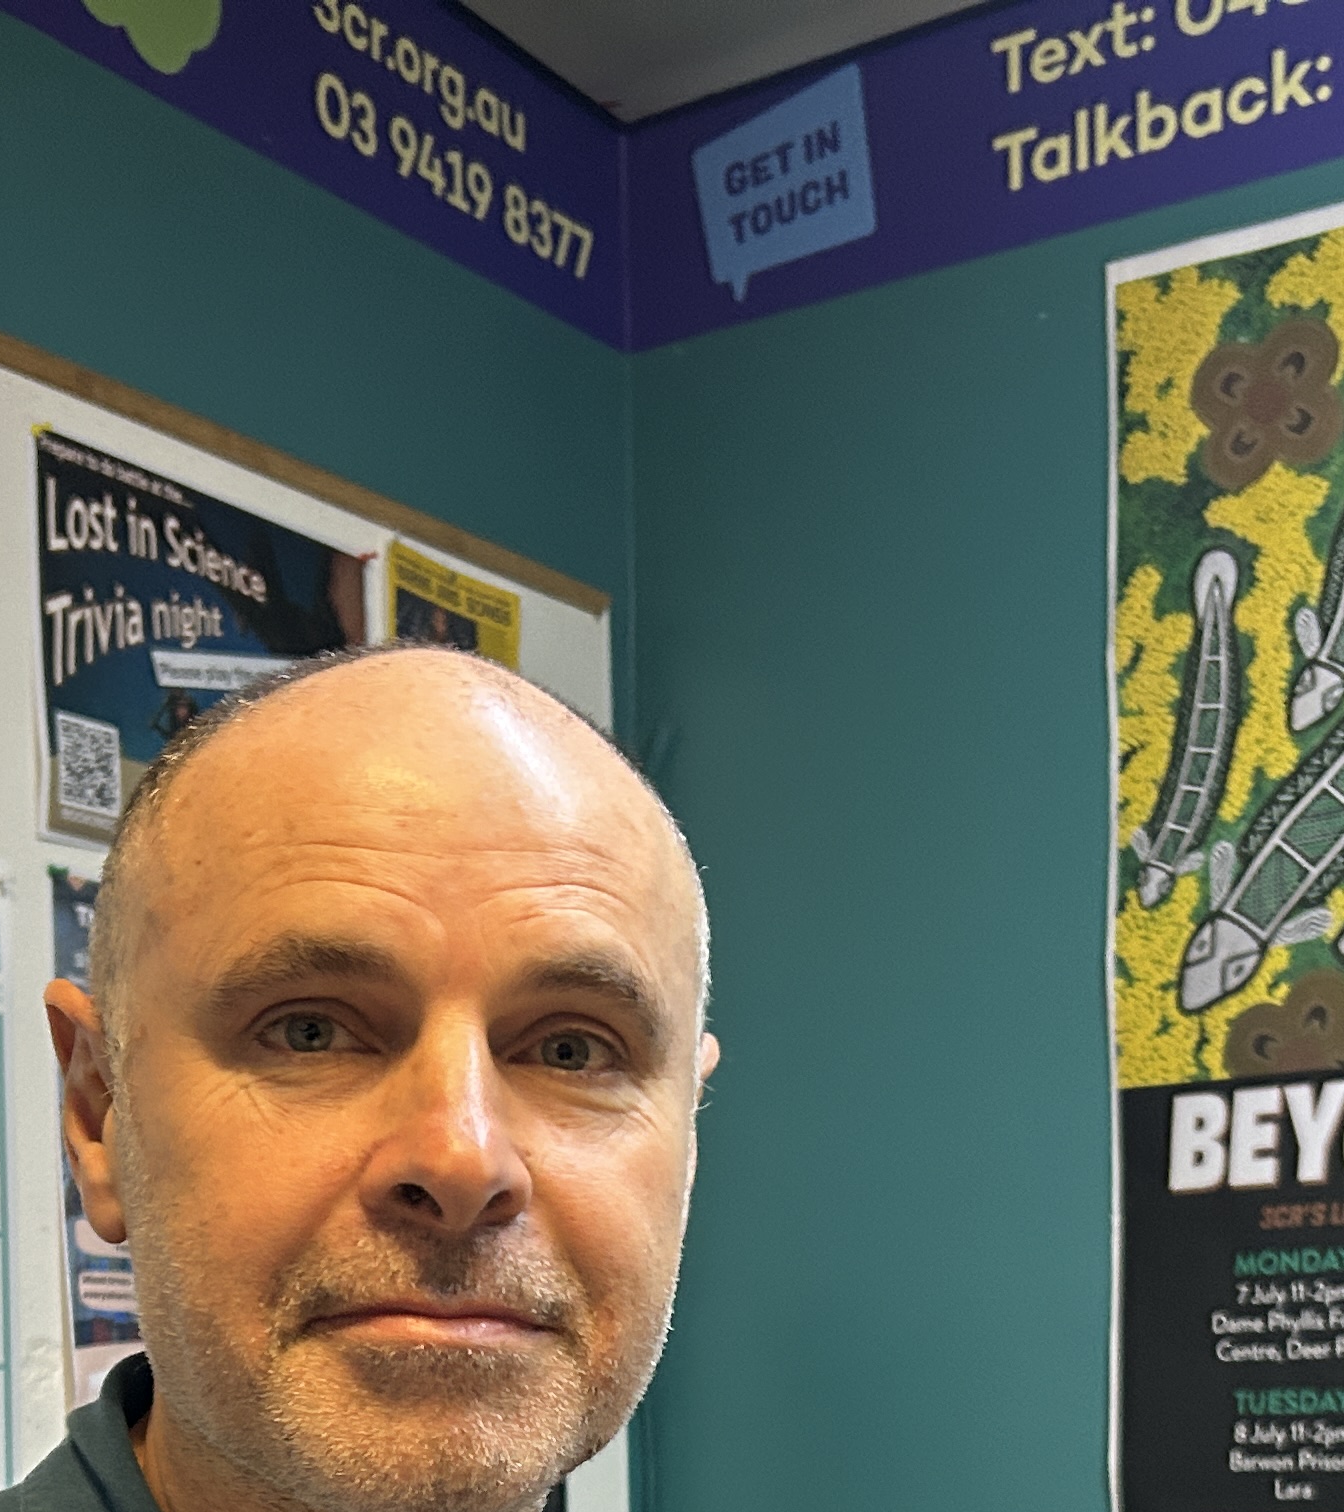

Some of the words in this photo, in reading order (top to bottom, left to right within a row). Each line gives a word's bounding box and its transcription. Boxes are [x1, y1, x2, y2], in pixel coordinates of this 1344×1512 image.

[314, 0, 526, 153] 3cr.org.au
[991, 5, 1158, 95] Text:
[992, 44, 1335, 194] Talkback:
[315, 71, 379, 158] 03
[388, 115, 493, 221] 9419
[502, 184, 594, 280] 8377
[722, 142, 793, 199] GET
[803, 119, 843, 166] IN
[727, 170, 851, 248] TOUCH
[45, 475, 118, 552] Lost
[128, 498, 157, 561] in
[167, 515, 268, 605] Science
[46, 584, 144, 687] Trivia
[152, 591, 223, 650] night
[1212, 1309, 1267, 1334] Dame
[1268, 1307, 1327, 1339] Phyllis
[1251, 1280, 1288, 1310] July
[1285, 1337, 1332, 1361] Deer
[1228, 1446, 1295, 1473] Barwon
[1250, 1420, 1288, 1450] July
[1274, 1477, 1315, 1501] Lara
